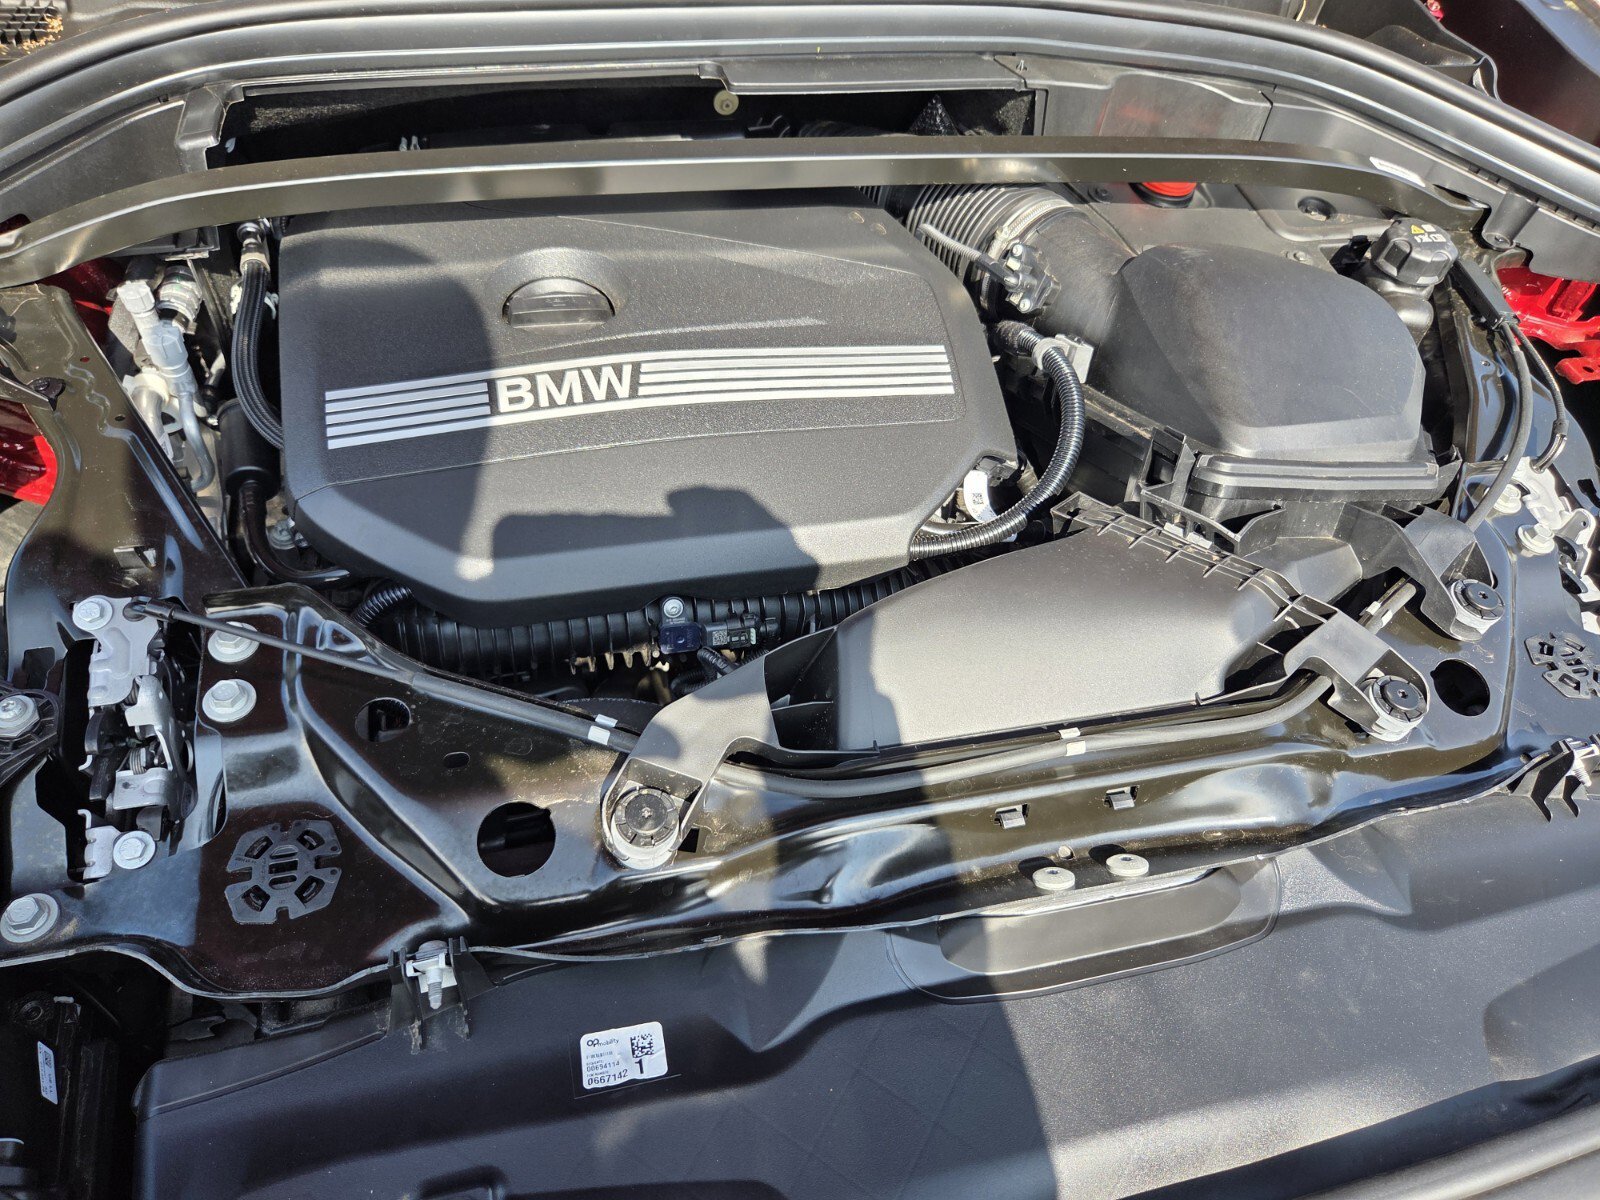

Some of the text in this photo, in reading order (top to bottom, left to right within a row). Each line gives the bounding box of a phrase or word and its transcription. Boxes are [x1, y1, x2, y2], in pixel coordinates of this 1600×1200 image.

[495, 363, 633, 413] BMW
[635, 1059, 644, 1074] 1
[587, 1069, 628, 1085] 0667142
